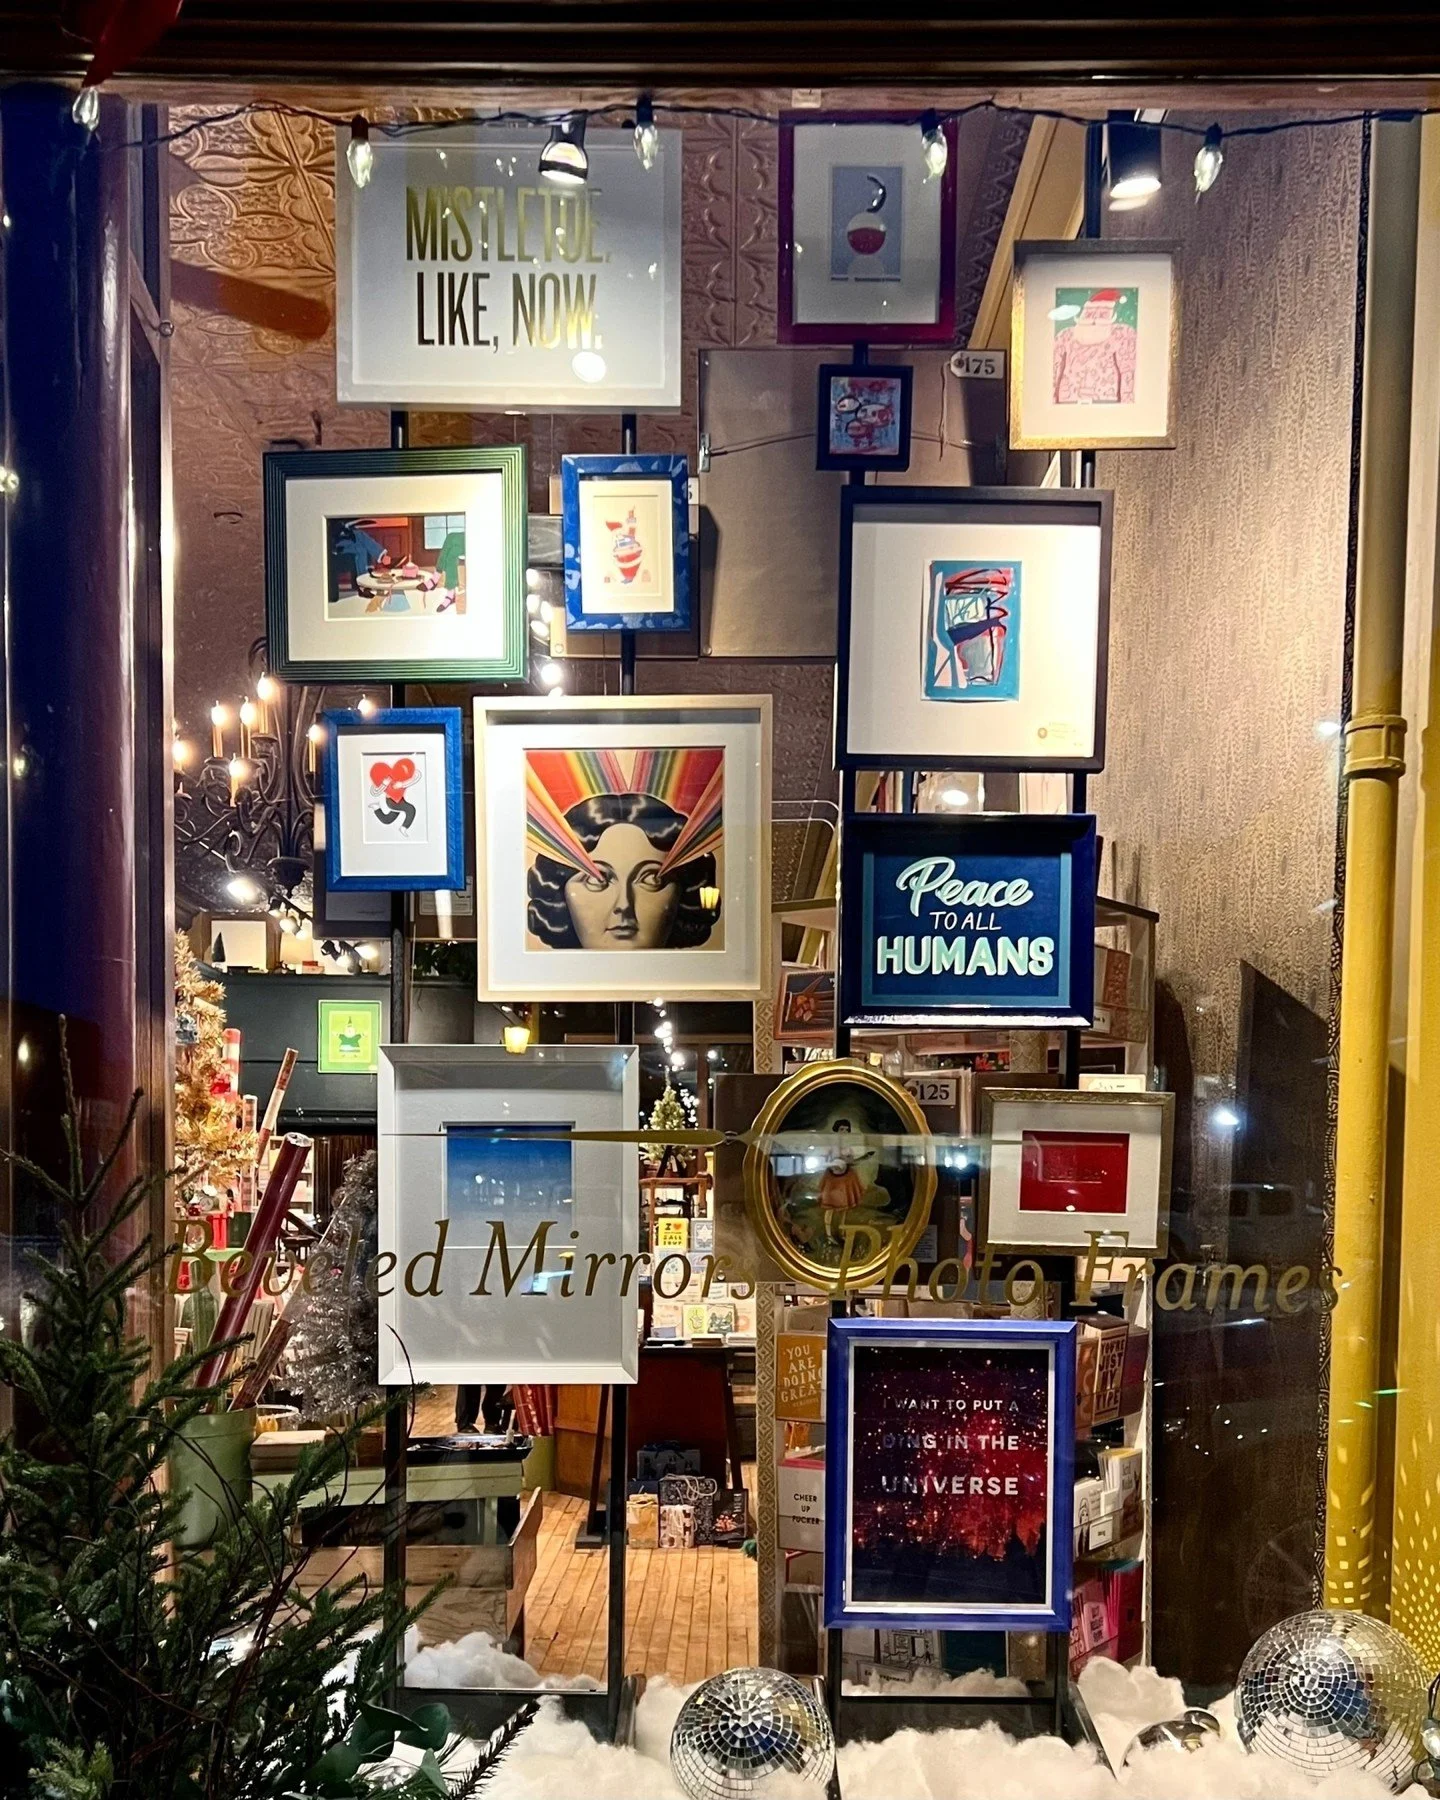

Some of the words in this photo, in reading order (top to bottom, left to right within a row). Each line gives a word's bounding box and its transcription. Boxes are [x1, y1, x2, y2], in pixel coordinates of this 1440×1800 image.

[417, 271, 499, 353] LIKE,
[512, 272, 602, 350] NOW.
[895, 856, 1034, 917] Peace
[929, 911, 957, 931] TO
[961, 911, 1002, 931] ALL
[876, 936, 1055, 977] HUMANS
[167, 1218, 450, 1298] Beveled
[469, 1220, 757, 1300] Mirrors
[828, 1224, 1045, 1307] Photo
[1069, 1230, 1343, 1314] Frames
[786, 1344, 811, 1361] YOU
[788, 1356, 816, 1375] ARE
[780, 1381, 822, 1403] GREA
[895, 1399, 940, 1410] WANT
[946, 1399, 966, 1411] TO
[973, 1399, 1003, 1411] PUT
[1009, 1400, 1019, 1412] A
[883, 1433, 937, 1450] DING
[947, 1435, 969, 1450] IN
[978, 1435, 1019, 1451] THE
[881, 1475, 1019, 1495] UNIVERSE
[793, 1493, 818, 1503] CHEER
[801, 1505, 811, 1513] UP
[792, 1515, 821, 1526] FUCKER
